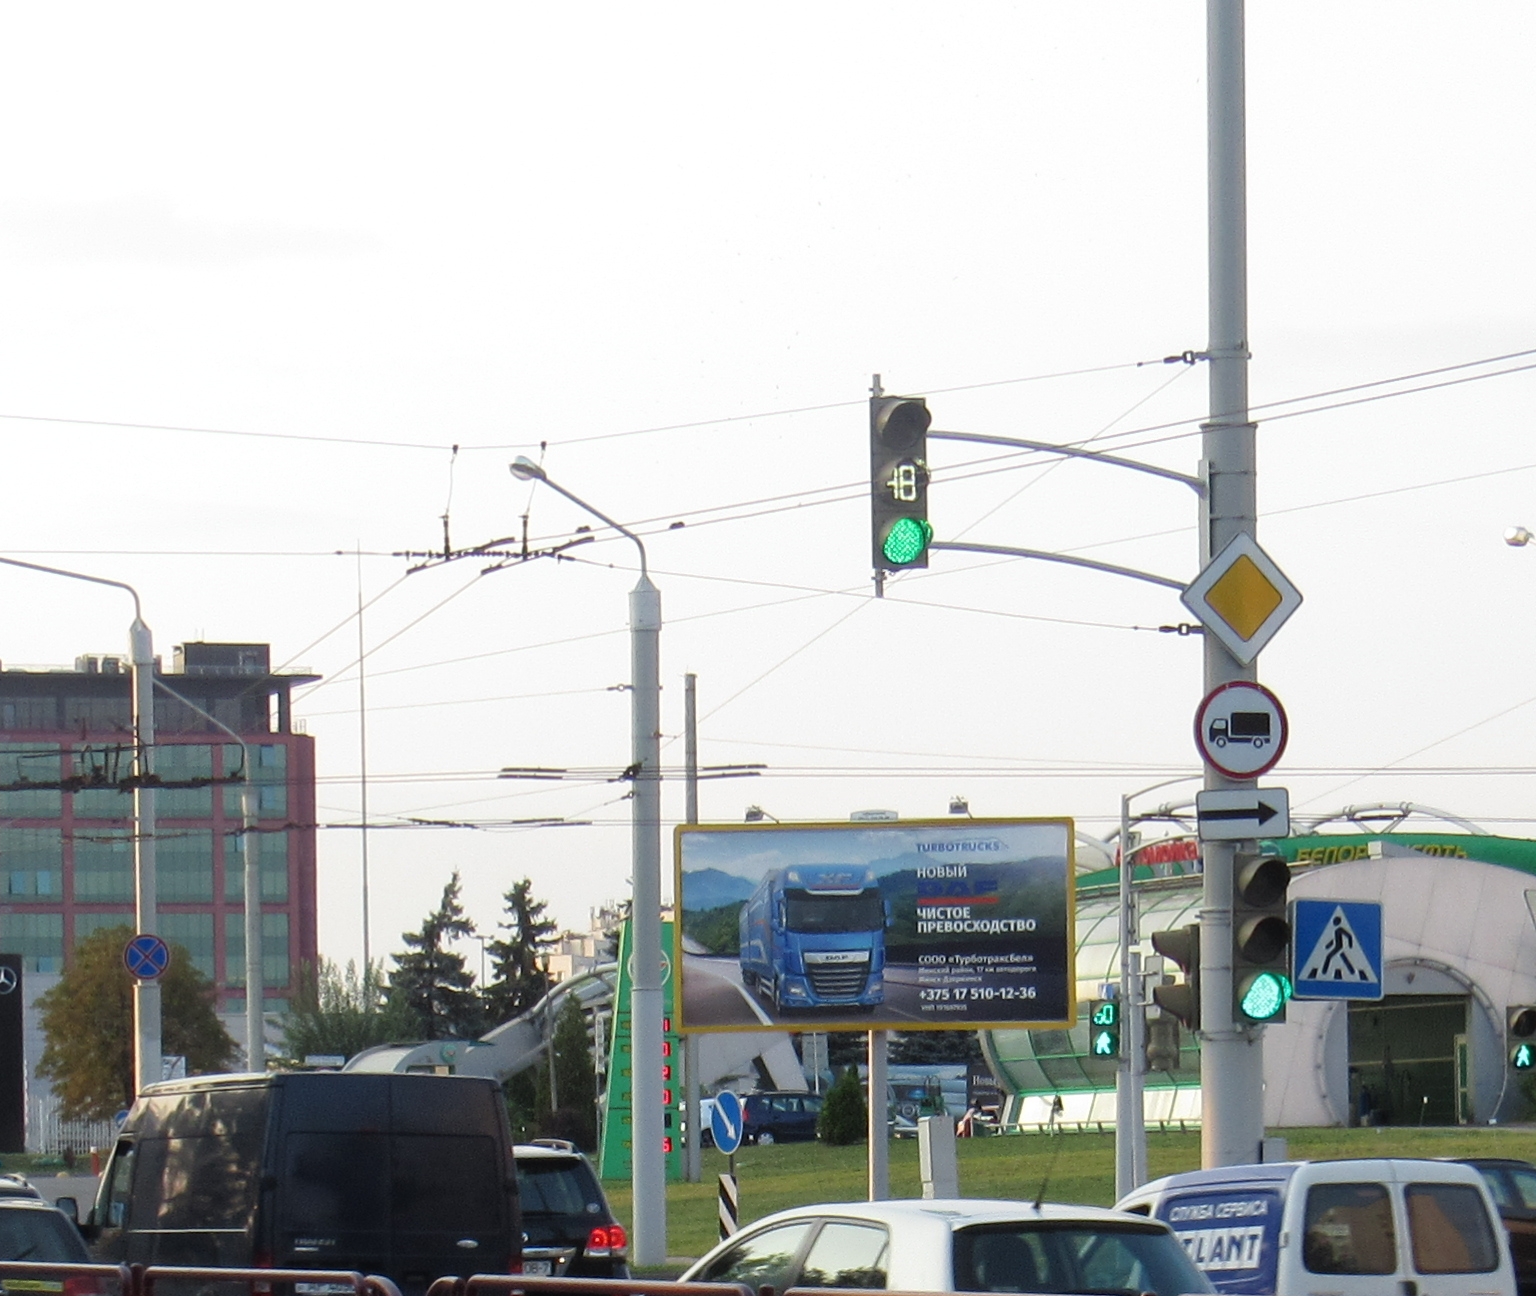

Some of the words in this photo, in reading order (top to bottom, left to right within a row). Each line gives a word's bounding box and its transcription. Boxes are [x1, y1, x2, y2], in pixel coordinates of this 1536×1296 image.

[916, 842, 1001, 853] TURBOTRUCKS
[917, 865, 967, 878] НОВЫЙ
[917, 880, 998, 896] DAF
[917, 907, 971, 919] ЧИСТОЕ
[917, 919, 1036, 934] ПРЕВОСХОДСТВО
[918, 955, 946, 964] СООО
[919, 989, 950, 1000] +375
[953, 988, 967, 1000] 17
[970, 987, 1037, 1000] 510-12-36
[1169, 1204, 1214, 1221] СЛУЖБА
[1215, 1200, 1268, 1219] СЕРВИСА
[1182, 1235, 1260, 1262] LANT
